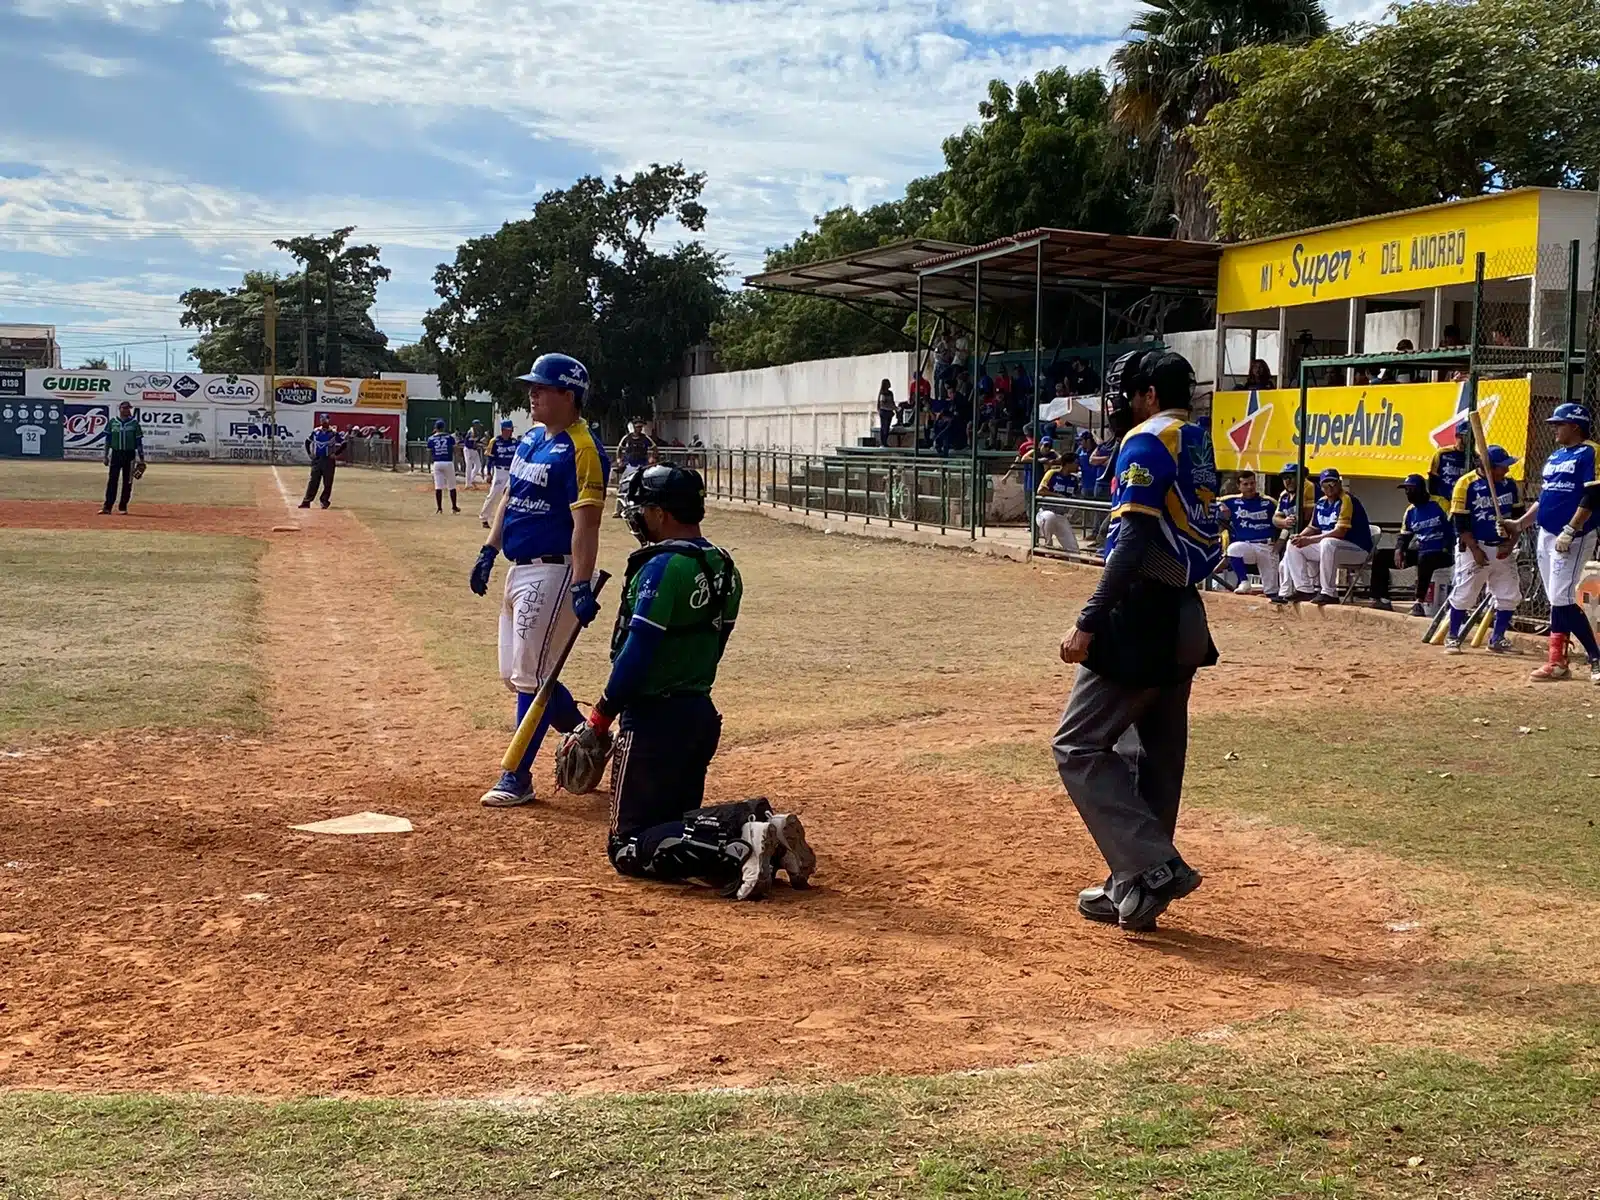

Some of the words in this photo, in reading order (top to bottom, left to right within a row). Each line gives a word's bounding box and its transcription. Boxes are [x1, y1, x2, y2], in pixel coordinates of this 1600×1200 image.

[1260, 263, 1273, 292] MI
[1289, 243, 1352, 297] Super
[1380, 241, 1403, 275] DEL
[1409, 228, 1466, 271] AHORRO
[43, 377, 112, 392] GUIBER
[208, 386, 254, 396] CASAR
[320, 396, 353, 405] SoniGas
[1292, 391, 1404, 458] SuperÁvila
[26, 433, 37, 442] 32
[433, 439, 448, 448] 32
